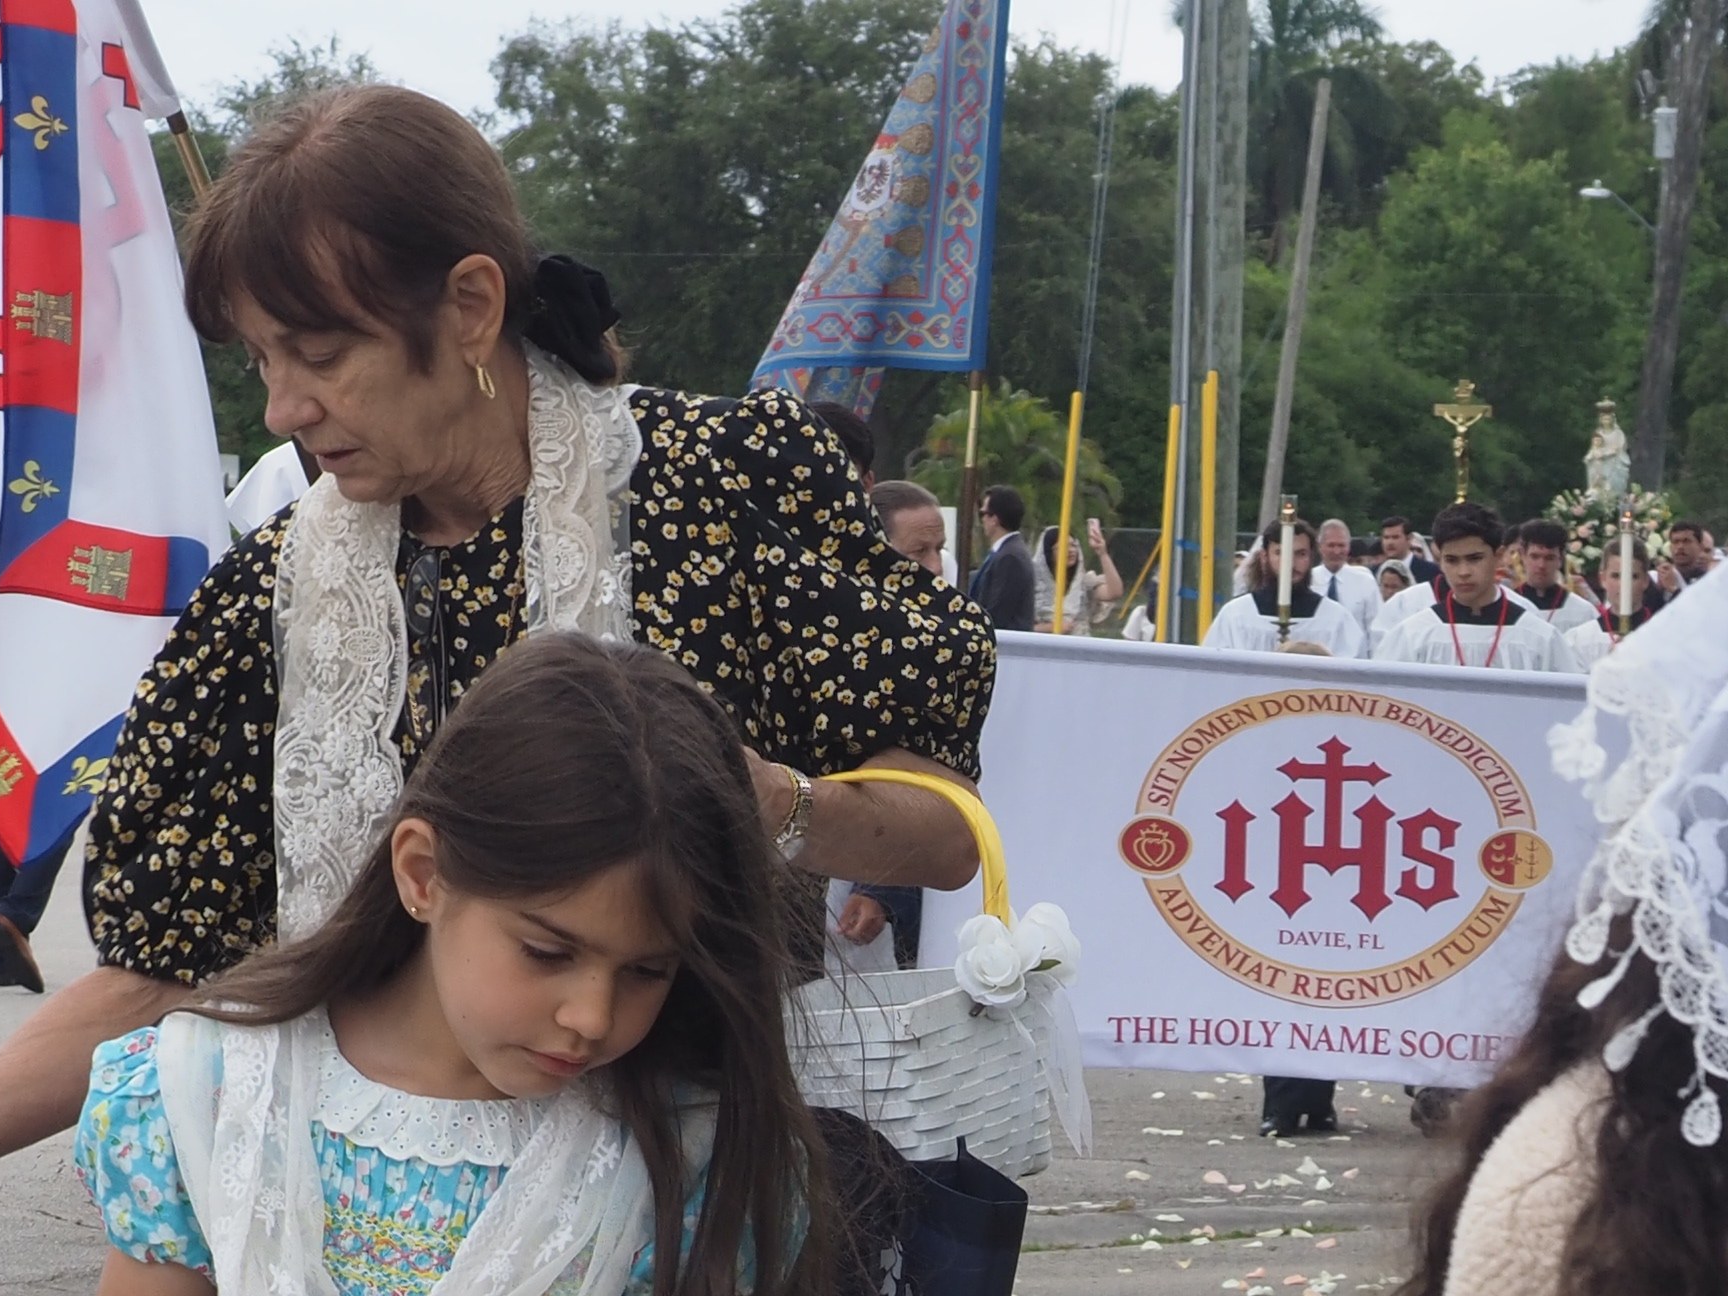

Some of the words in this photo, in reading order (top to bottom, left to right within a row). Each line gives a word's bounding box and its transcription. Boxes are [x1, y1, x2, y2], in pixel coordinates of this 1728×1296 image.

[1147, 768, 1180, 807] SIT
[1166, 703, 1258, 771] NOMEN
[1259, 693, 1380, 719] DOMINI
[1382, 702, 1526, 819] BENEDICTUM
[1214, 735, 1463, 923] IHS
[1157, 887, 1287, 988] ADVENIAT
[1290, 959, 1435, 1001] REGNUM
[1432, 895, 1511, 968] TUUM
[1278, 929, 1352, 950] DAVIE,
[1359, 933, 1385, 950] FL
[1107, 1016, 1180, 1044] THE
[1188, 1017, 1282, 1048] HOLY
[1288, 1022, 1391, 1055] NAME
